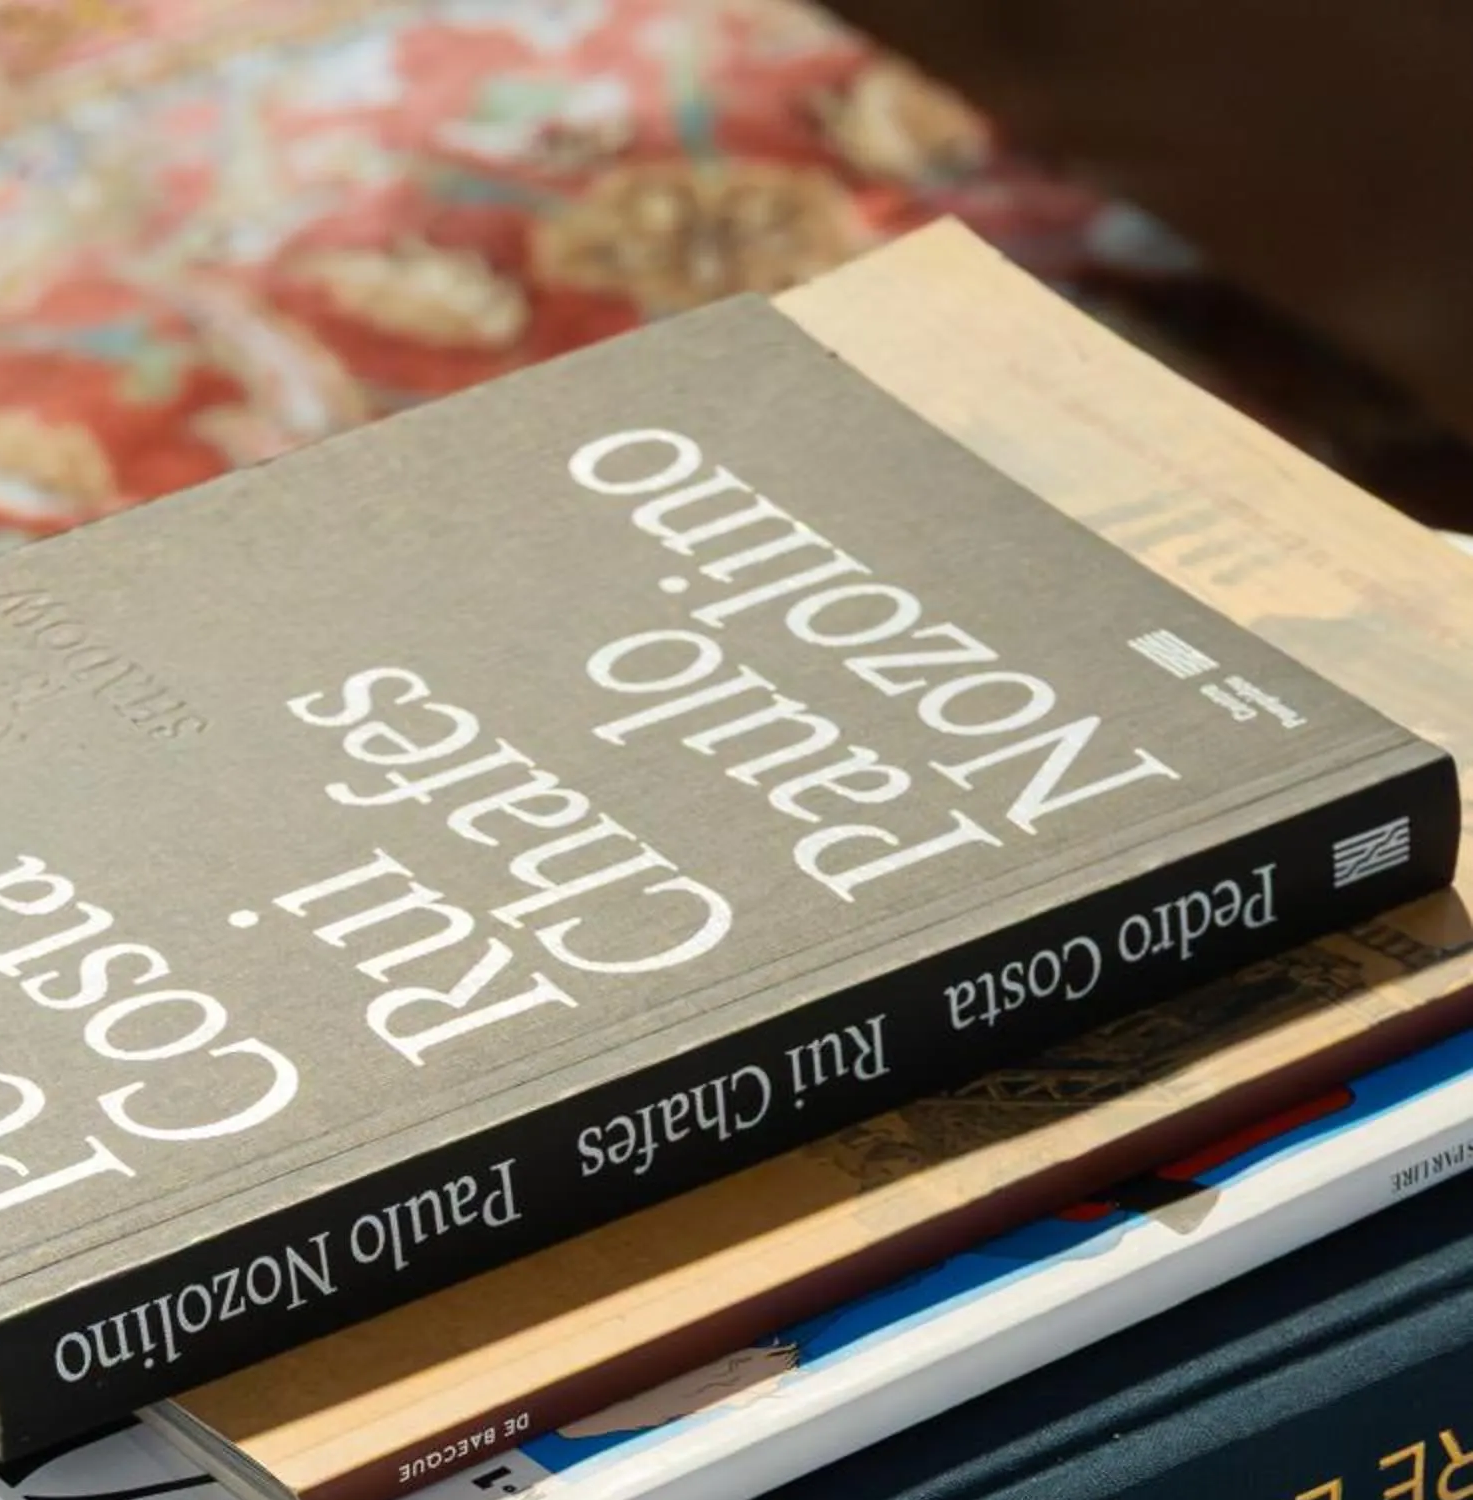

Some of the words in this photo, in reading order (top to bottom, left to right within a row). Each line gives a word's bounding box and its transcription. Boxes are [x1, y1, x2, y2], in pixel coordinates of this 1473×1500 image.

[568, 429, 1178, 844] Nozolino
[286, 667, 732, 973] Chafes
[586, 630, 1002, 902] Paulo
[227, 847, 578, 1066] Rui
[1119, 864, 1276, 962] Pedro
[944, 937, 1102, 1030] Costa
[786, 1014, 890, 1110] Rui
[578, 1066, 772, 1177] Chafes
[350, 1158, 522, 1270] Paulo
[54, 1231, 338, 1382] Nozolino
[398, 1427, 496, 1483] BAECQUE
[504, 1413, 530, 1437] DE
